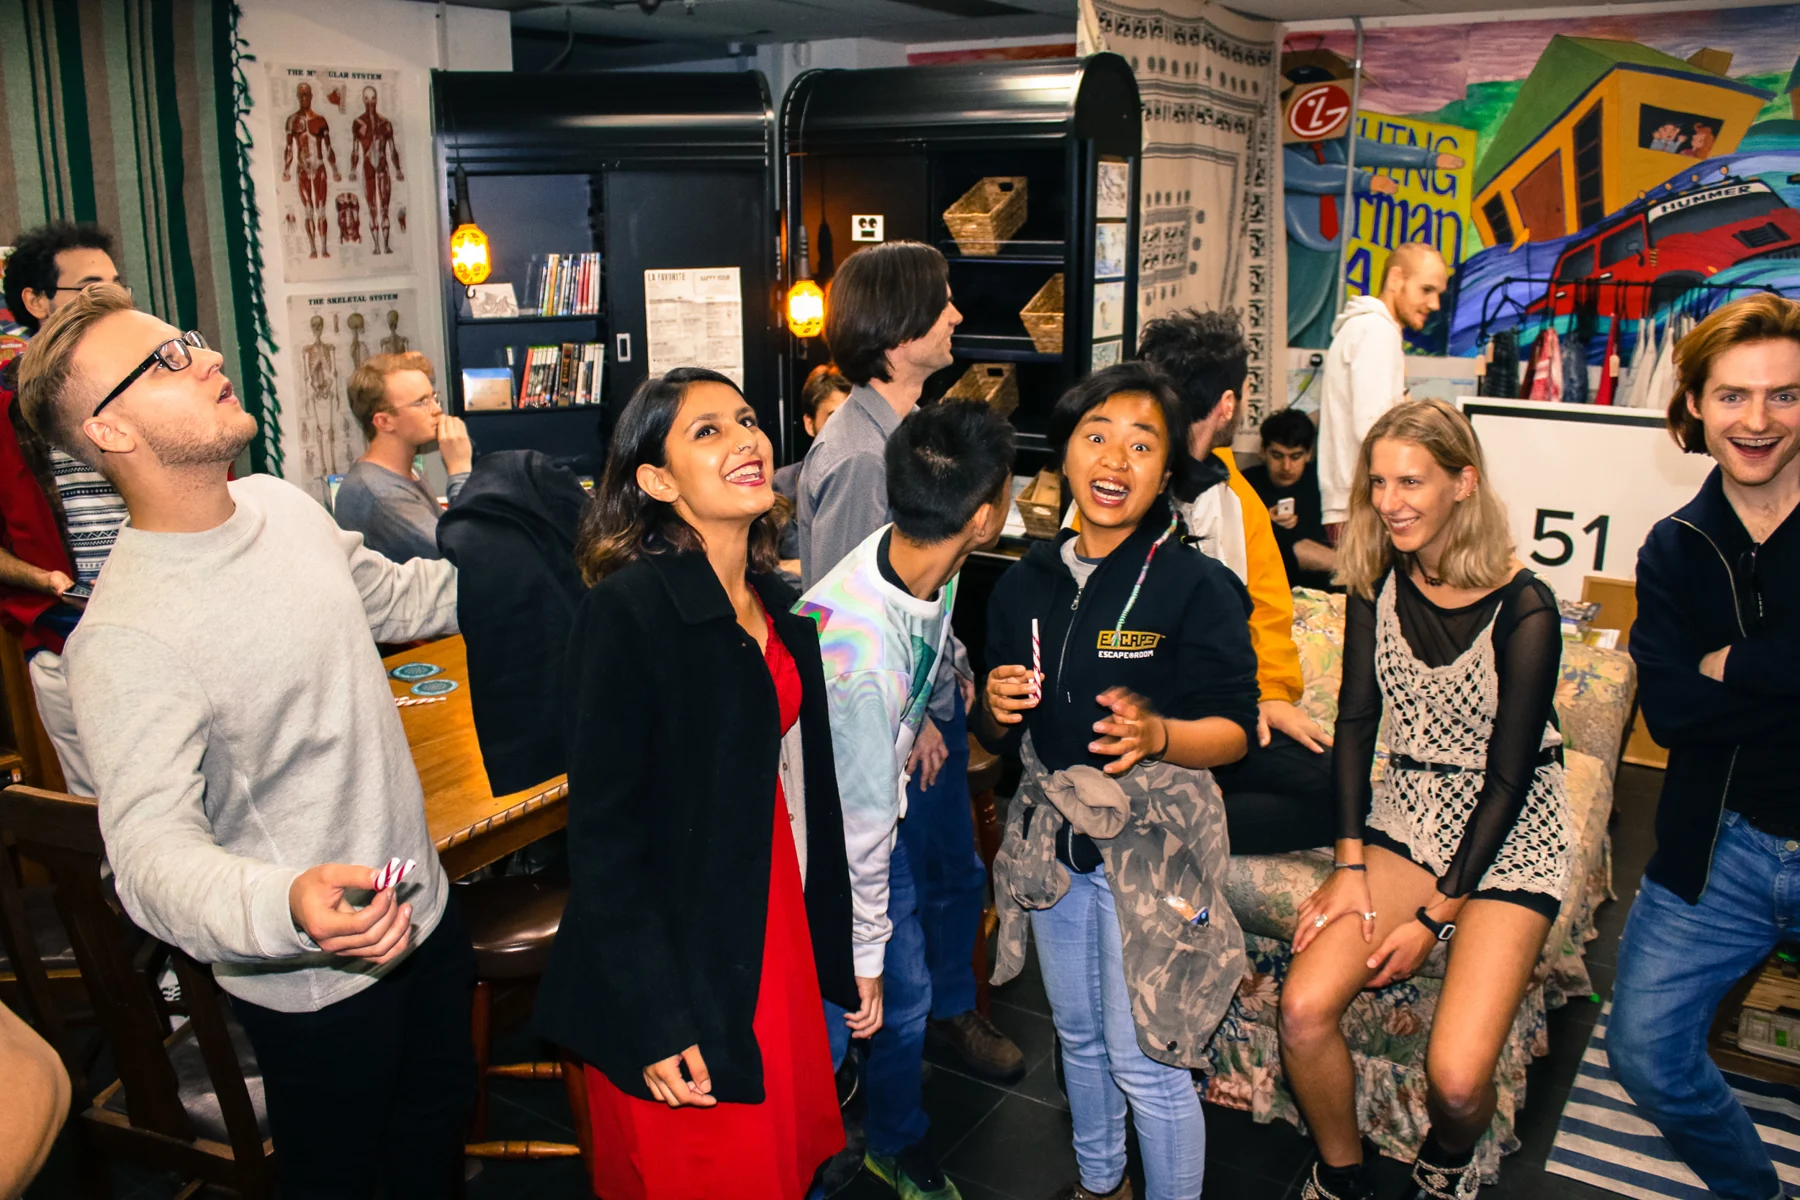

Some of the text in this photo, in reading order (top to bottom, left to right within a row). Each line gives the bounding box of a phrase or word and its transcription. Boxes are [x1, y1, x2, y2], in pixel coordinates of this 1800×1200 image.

[306, 69, 348, 79] MULAR
[352, 72, 382, 80] SYSTEM
[1288, 86, 1349, 137] LG
[1660, 185, 1751, 213] HUMMER
[327, 295, 367, 304] SKELETAL
[369, 293, 398, 301] SYSTEM
[1530, 508, 1609, 571] 51
[1100, 633, 1157, 647] ECAPE
